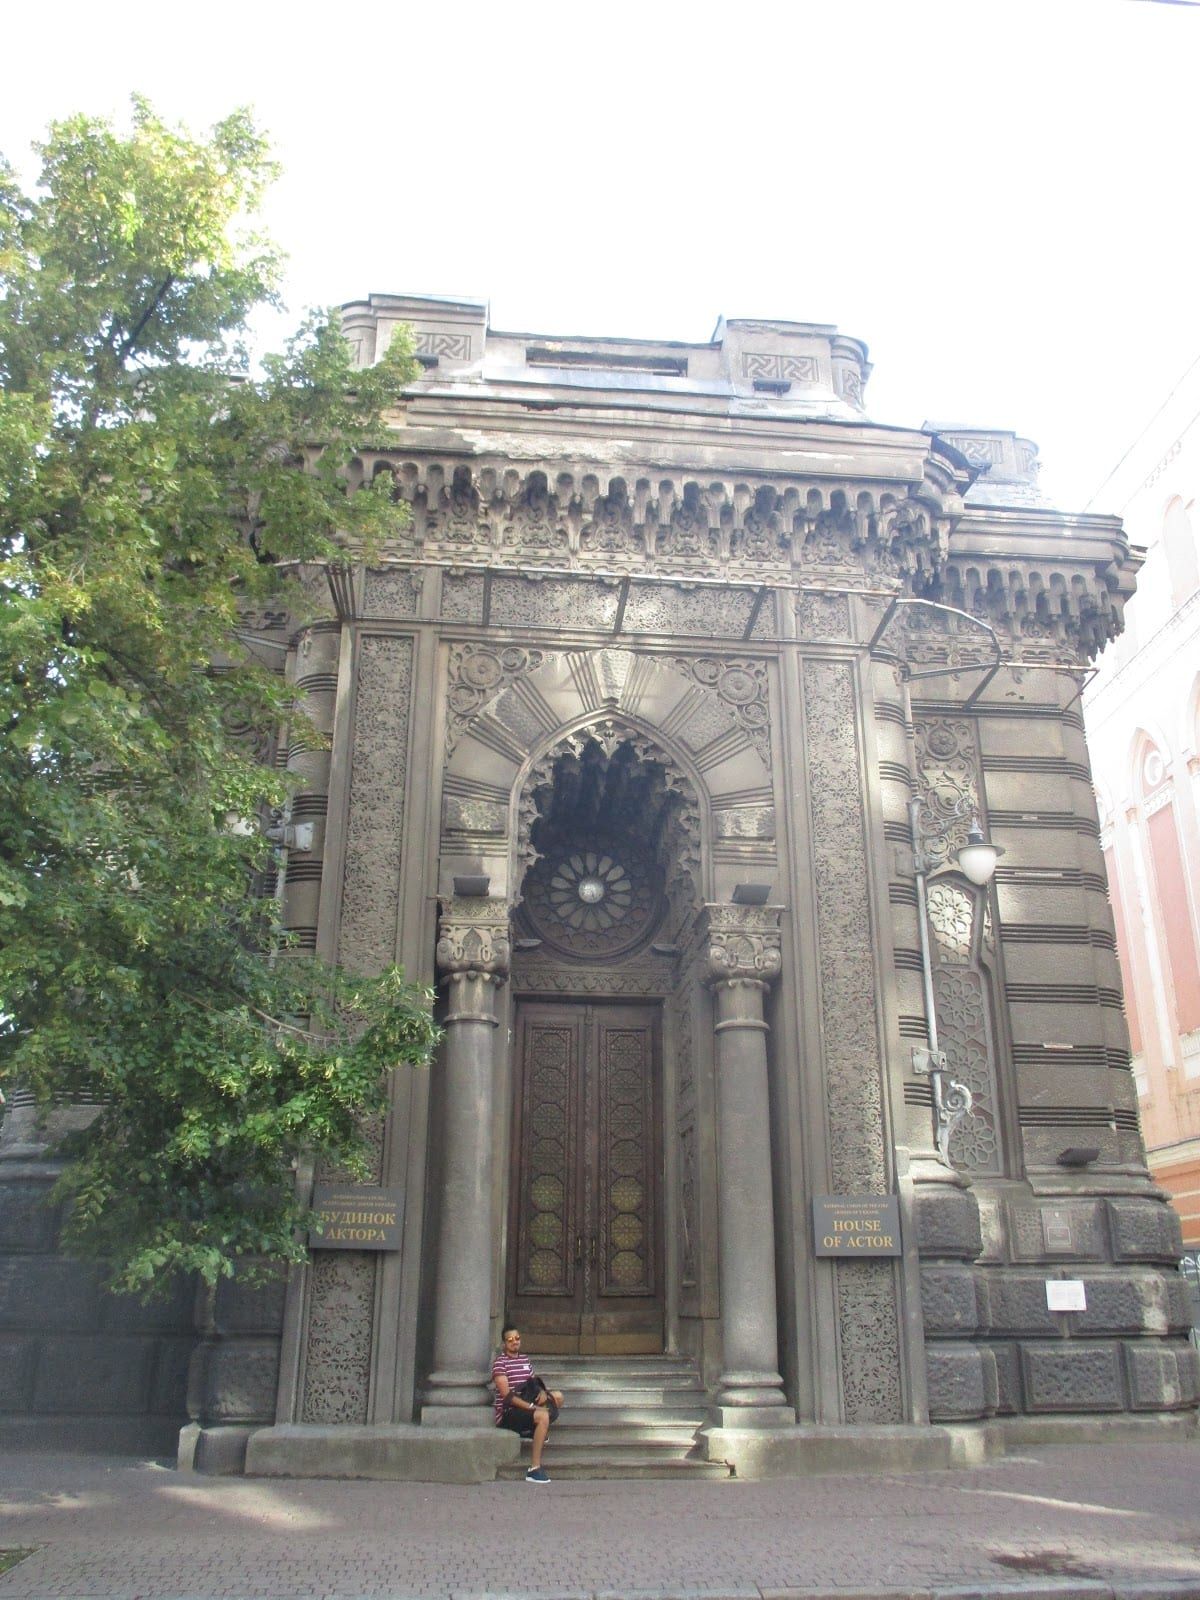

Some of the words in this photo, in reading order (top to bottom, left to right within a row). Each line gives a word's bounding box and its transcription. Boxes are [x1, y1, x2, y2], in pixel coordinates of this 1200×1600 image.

[320, 1211, 396, 1225] БУДИНОК
[833, 1220, 881, 1231] HOUSE
[325, 1228, 386, 1240] АКТОРА
[823, 1236, 841, 1248] OF
[847, 1236, 893, 1248] ACTOR
